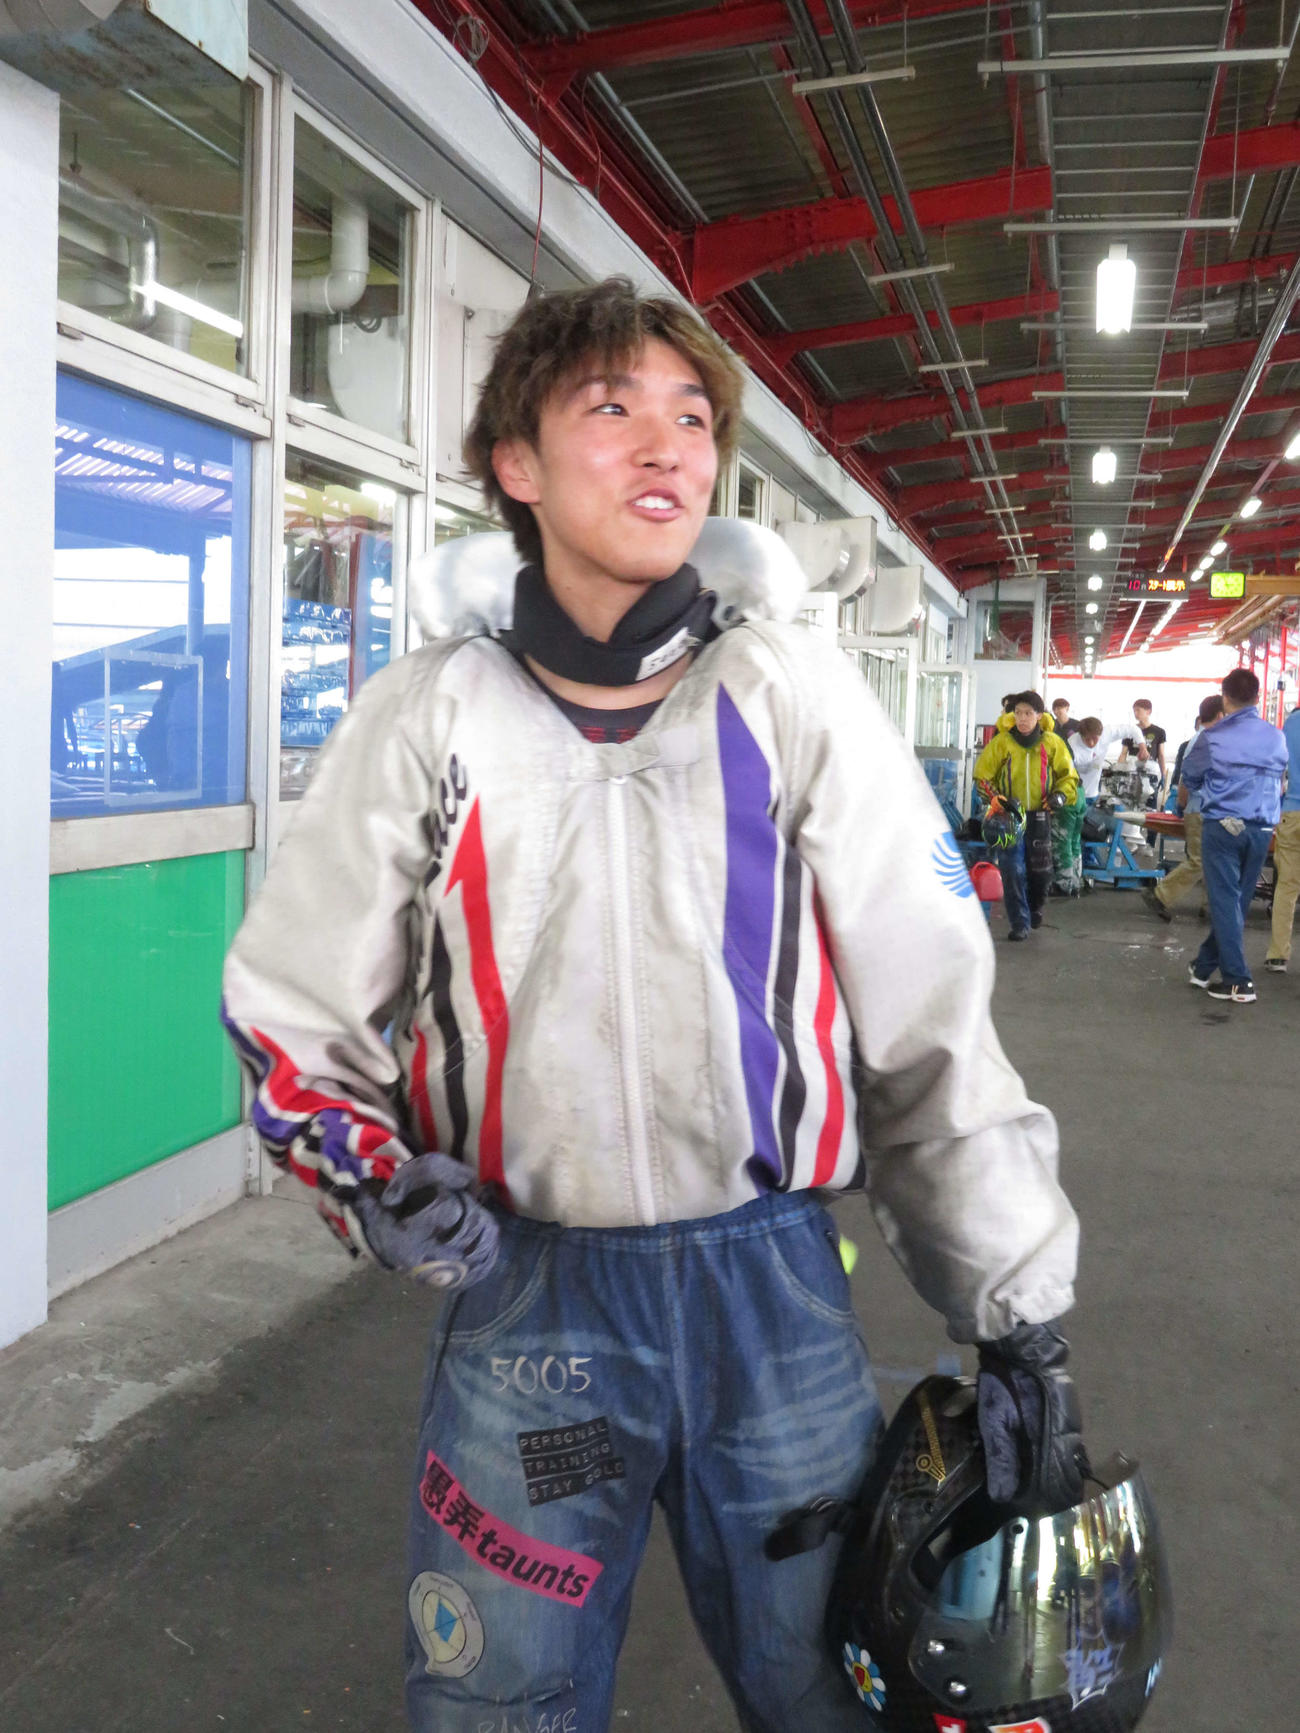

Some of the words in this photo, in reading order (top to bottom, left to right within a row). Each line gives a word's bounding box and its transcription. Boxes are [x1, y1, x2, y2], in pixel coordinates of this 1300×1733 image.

[491, 1355, 592, 1394] 5005
[519, 1422, 608, 1450] PERSONAL
[524, 1443, 611, 1473] TRAINING
[529, 1479, 573, 1500] STAY
[585, 1462, 624, 1485] GOLD
[476, 1529, 589, 1597] taunts
